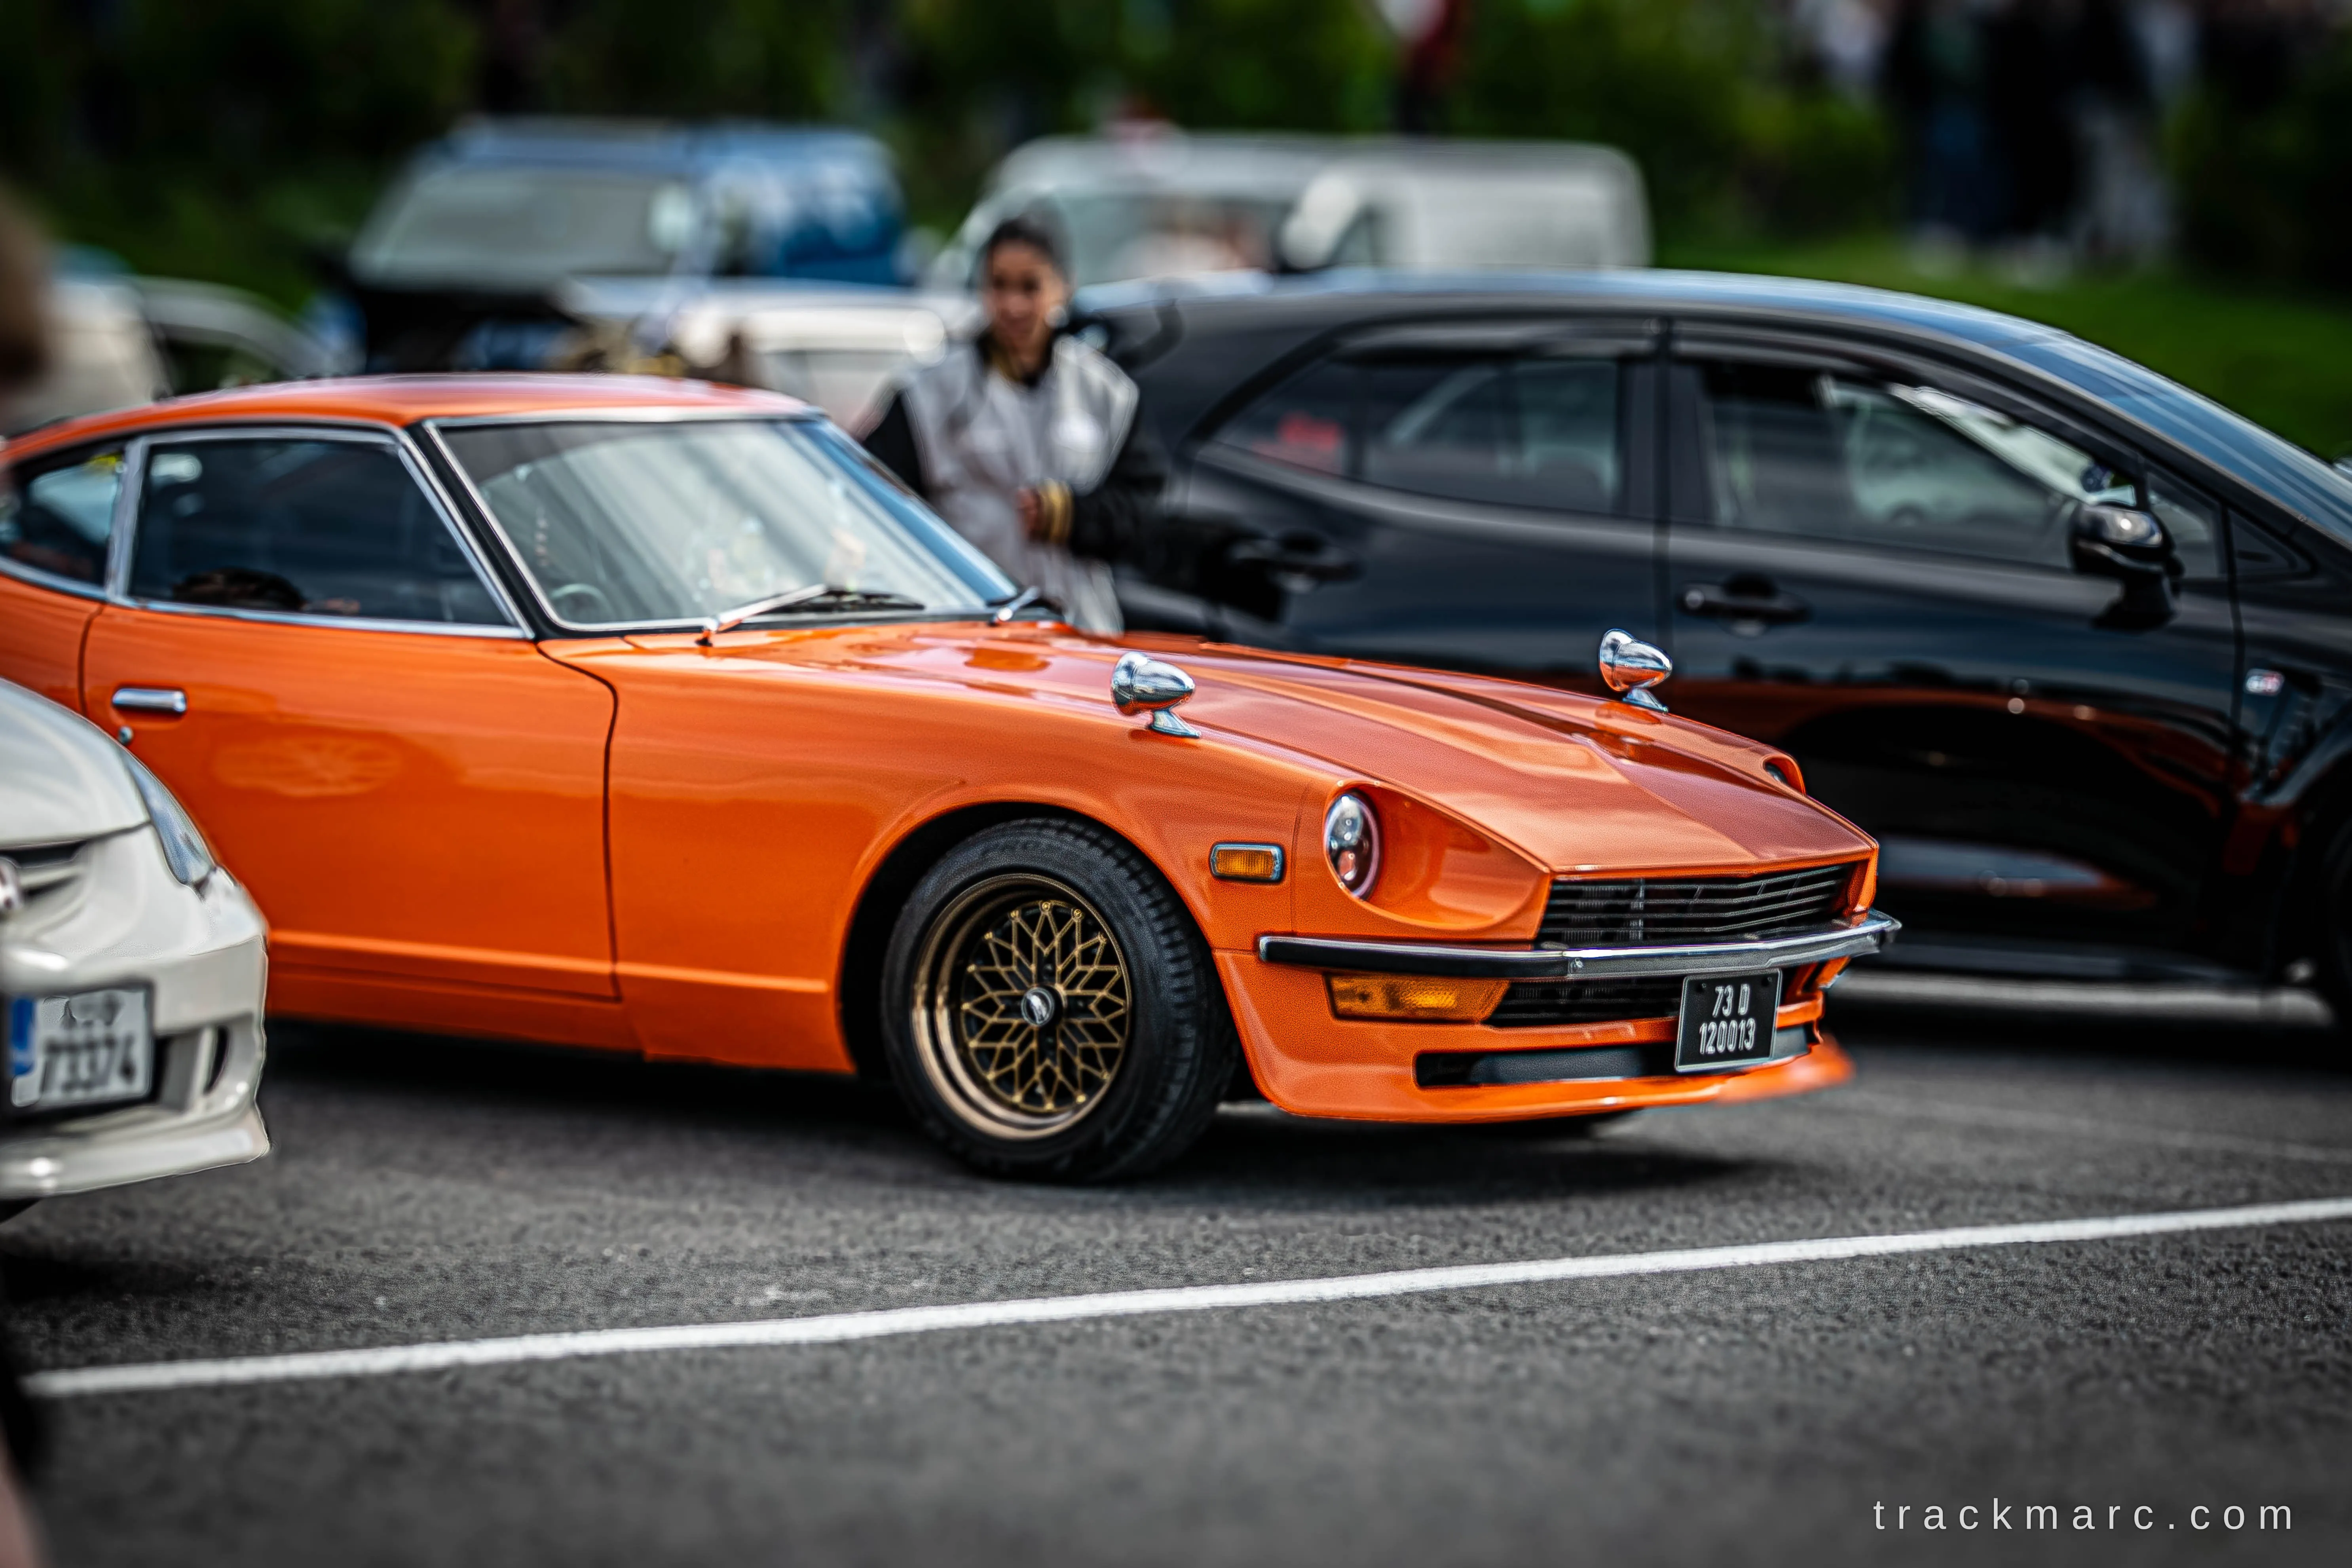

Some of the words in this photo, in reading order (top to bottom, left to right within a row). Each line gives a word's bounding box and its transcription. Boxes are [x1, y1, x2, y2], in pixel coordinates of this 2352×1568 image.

[1712, 985, 1733, 1017] 73
[1738, 983, 1750, 1015] D
[1699, 1017, 1756, 1054] 120013
